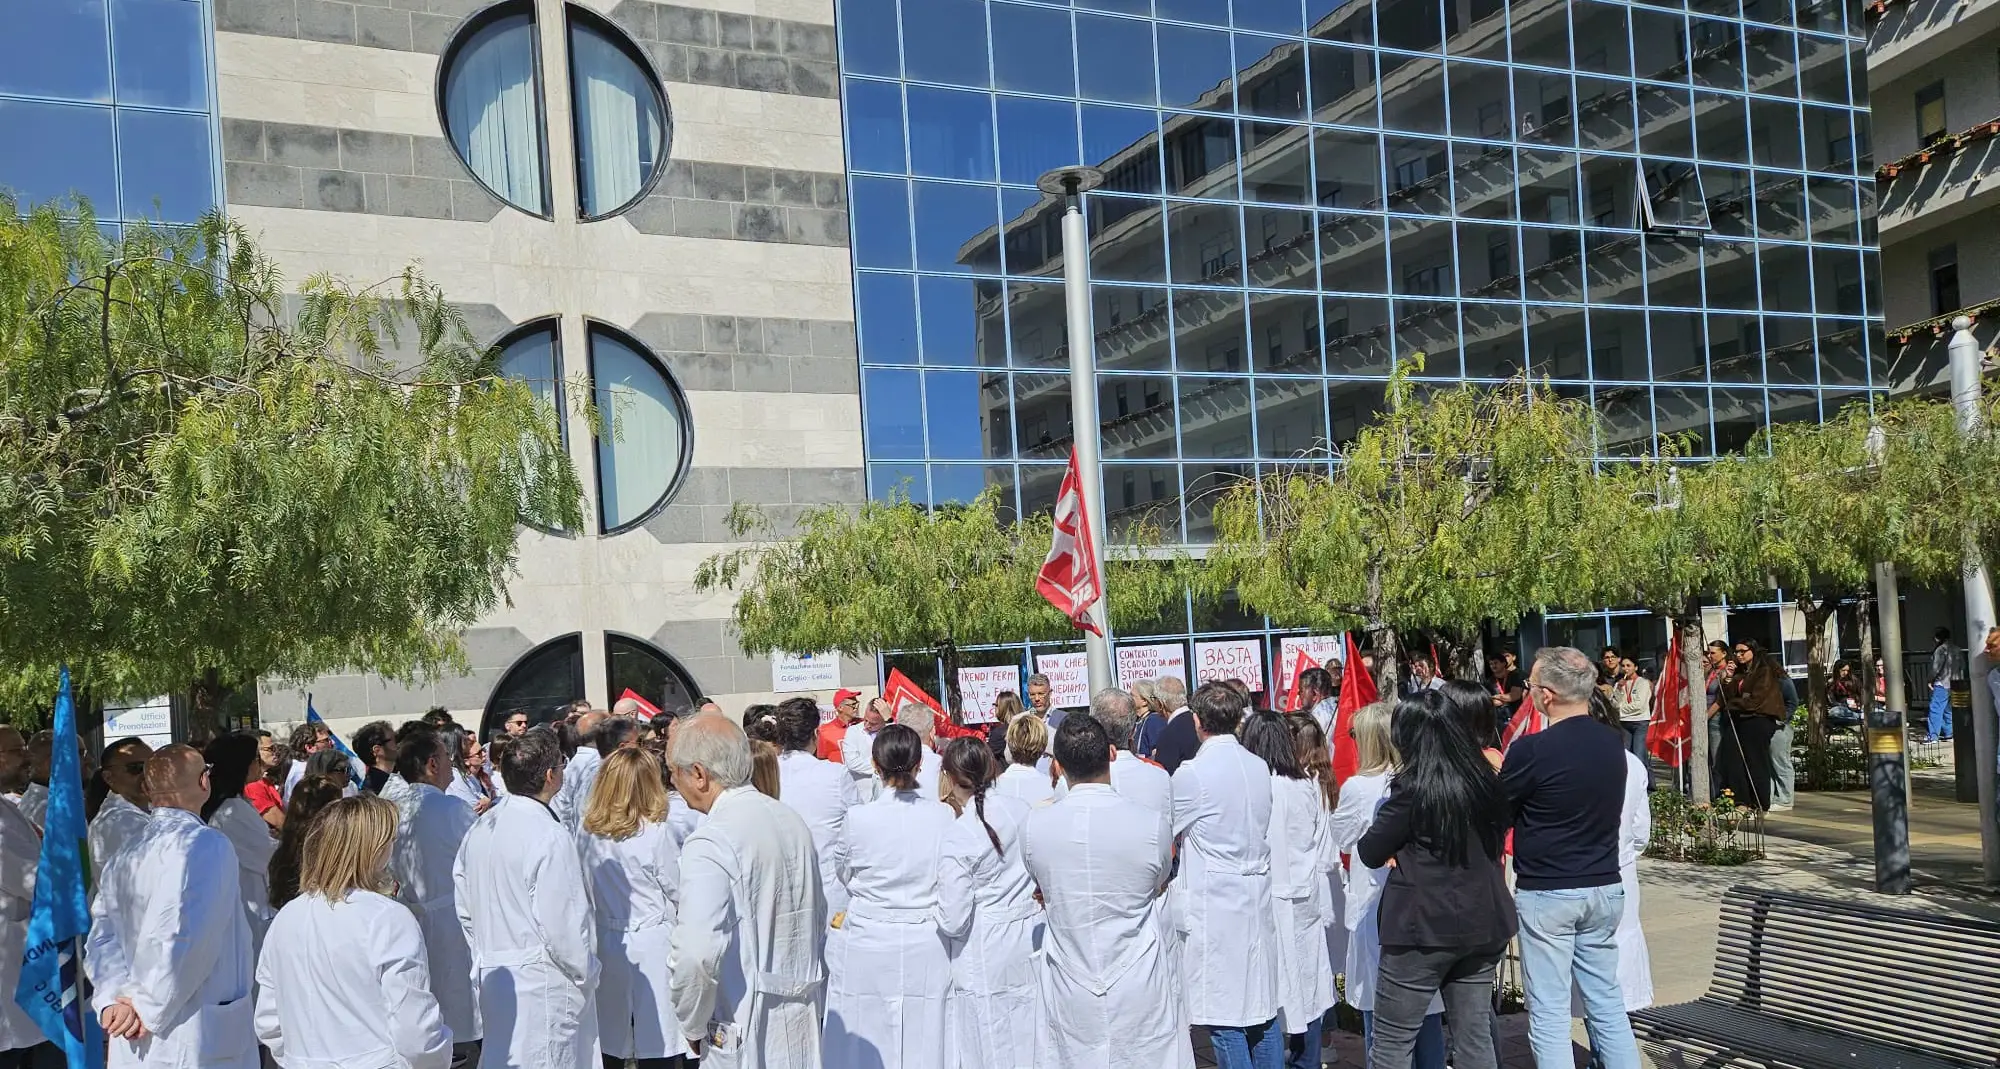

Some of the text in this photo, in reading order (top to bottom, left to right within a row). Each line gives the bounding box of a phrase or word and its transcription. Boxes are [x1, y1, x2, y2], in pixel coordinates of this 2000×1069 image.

[1119, 649, 1158, 660] CONTRATTO
[1204, 647, 1252, 666] BASTA
[1041, 659, 1059, 669] NON
[1120, 657, 1183, 669] SCADUTO DA ANNI
[992, 670, 1016, 682] FERMI
[1121, 668, 1157, 680] STIPENDI
[1199, 664, 1261, 684] PROMESSE
[140, 712, 166, 721] Ufficio
[118, 721, 167, 731] Prenotazioni
